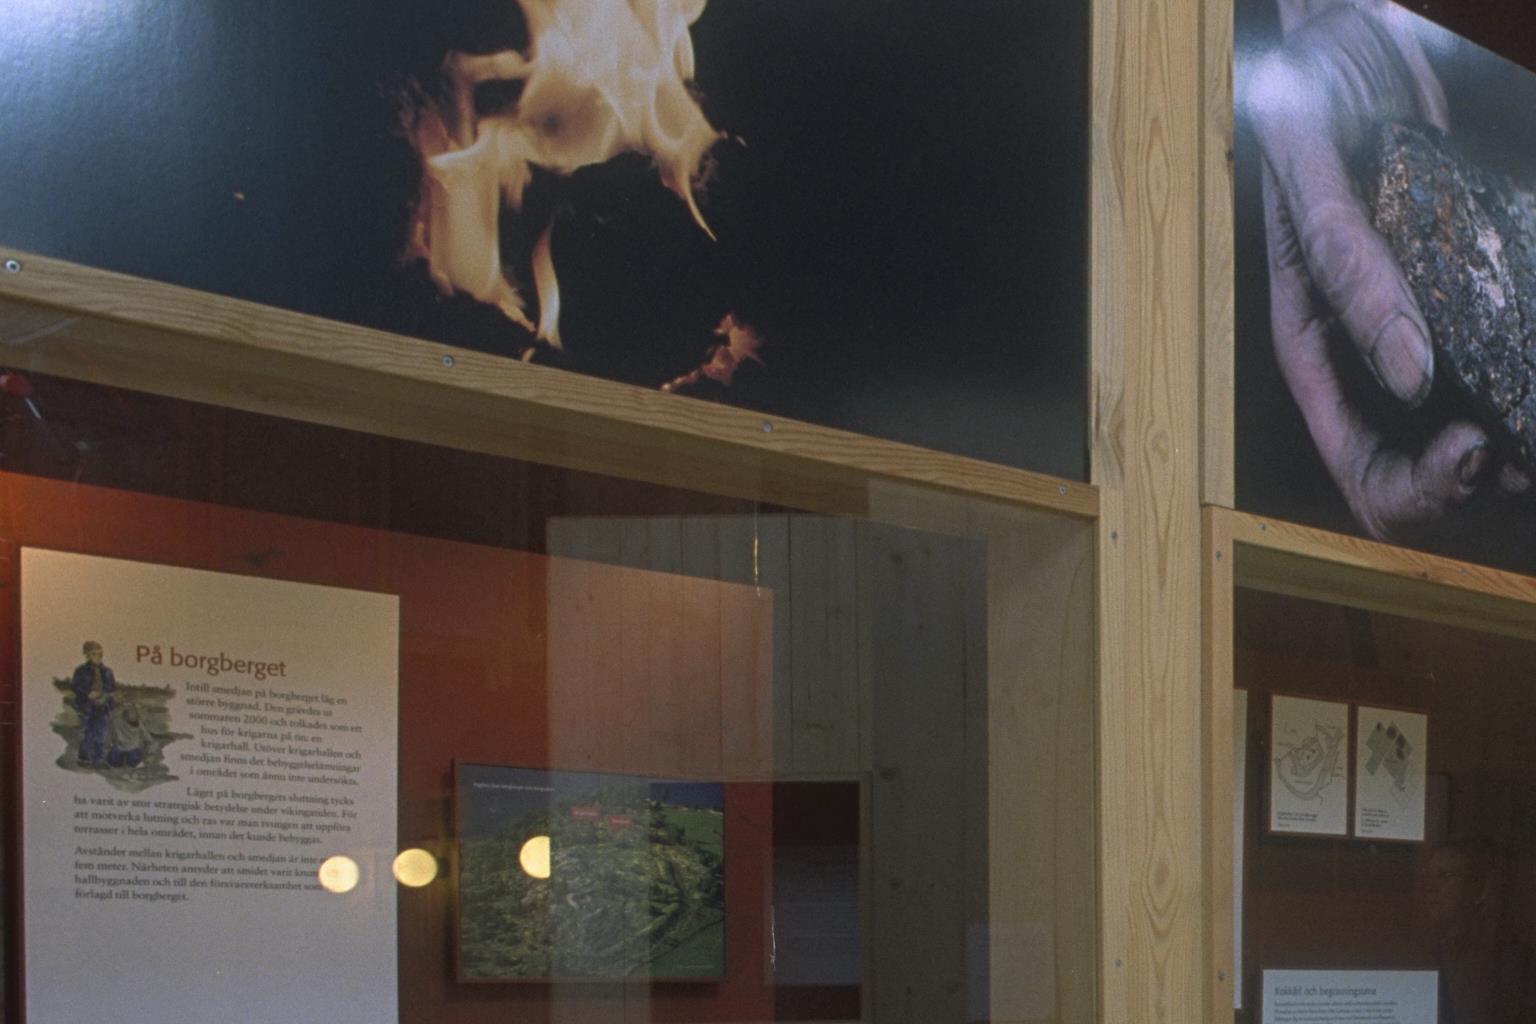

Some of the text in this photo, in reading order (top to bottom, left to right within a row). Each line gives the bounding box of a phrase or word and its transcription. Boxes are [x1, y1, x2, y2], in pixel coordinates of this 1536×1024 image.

[136, 644, 288, 681] På borgberget
[211, 686, 253, 698] smedjan
[254, 688, 266, 699] på
[335, 696, 348, 704] en
[185, 697, 215, 708] större
[216, 699, 262, 711] byggnad.
[264, 702, 284, 713] Den
[322, 708, 333, 716] ut
[188, 713, 241, 724] sommaren
[243, 715, 268, 726] 2000
[269, 717, 288, 727] och
[289, 718, 328, 730] tolkades
[329, 723, 349, 731] som
[200, 724, 218, 735] hus
[220, 726, 235, 736] för
[237, 727, 278, 739] krigarna
[279, 730, 292, 741] på
[310, 734, 322, 742] en
[179, 752, 222, 764] smedjan
[223, 754, 248, 765] finns
[248, 756, 265, 766] det
[253, 743, 286, 754] Utöver
[288, 745, 343, 758] krigarhallen
[344, 750, 362, 759] och
[189, 767, 194, 776] i
[195, 768, 238, 779] området
[239, 772, 260, 780] som
[73, 795, 88, 805] ha
[89, 796, 115, 806] varit
[116, 799, 130, 807] av
[131, 799, 152, 808] stor
[153, 799, 202, 812] strategisk
[203, 801, 249, 813] betydelse
[250, 804, 278, 814] under
[186, 787, 214, 799] Läget
[216, 789, 229, 800] på
[330, 795, 355, 806] tycks
[73, 811, 89, 820] att
[91, 811, 141, 822] motverka
[143, 813, 179, 826] lutning
[180, 815, 199, 825] och
[219, 818, 236, 826] var
[237, 819, 259, 827] man
[73, 825, 119, 835] terrasser
[121, 826, 126, 836] i
[127, 826, 149, 836] hela
[199, 829, 228, 839] innan
[228, 830, 246, 840] det
[246, 831, 277, 841] kunde
[74, 845, 127, 856] Avståndet
[128, 847, 163, 857] mellan
[164, 848, 226, 860] krigarhallen
[227, 851, 246, 860] och
[247, 852, 287, 863] smedjan
[287, 853, 299, 862] är
[74, 861, 95, 870] fem
[96, 862, 129, 871] meter.
[131, 862, 179, 873] Närheten
[180, 864, 219, 875] antyder
[220, 866, 236, 874] att
[236, 865, 270, 875] smidet
[270, 866, 293, 876] varit
[74, 875, 151, 887] hallbyggnaden
[152, 877, 171, 886] och
[172, 877, 188, 887] till
[189, 878, 209, 887] den
[74, 889, 113, 901] förlagd
[114, 890, 130, 899] till
[1304, 985, 1317, 996] och
